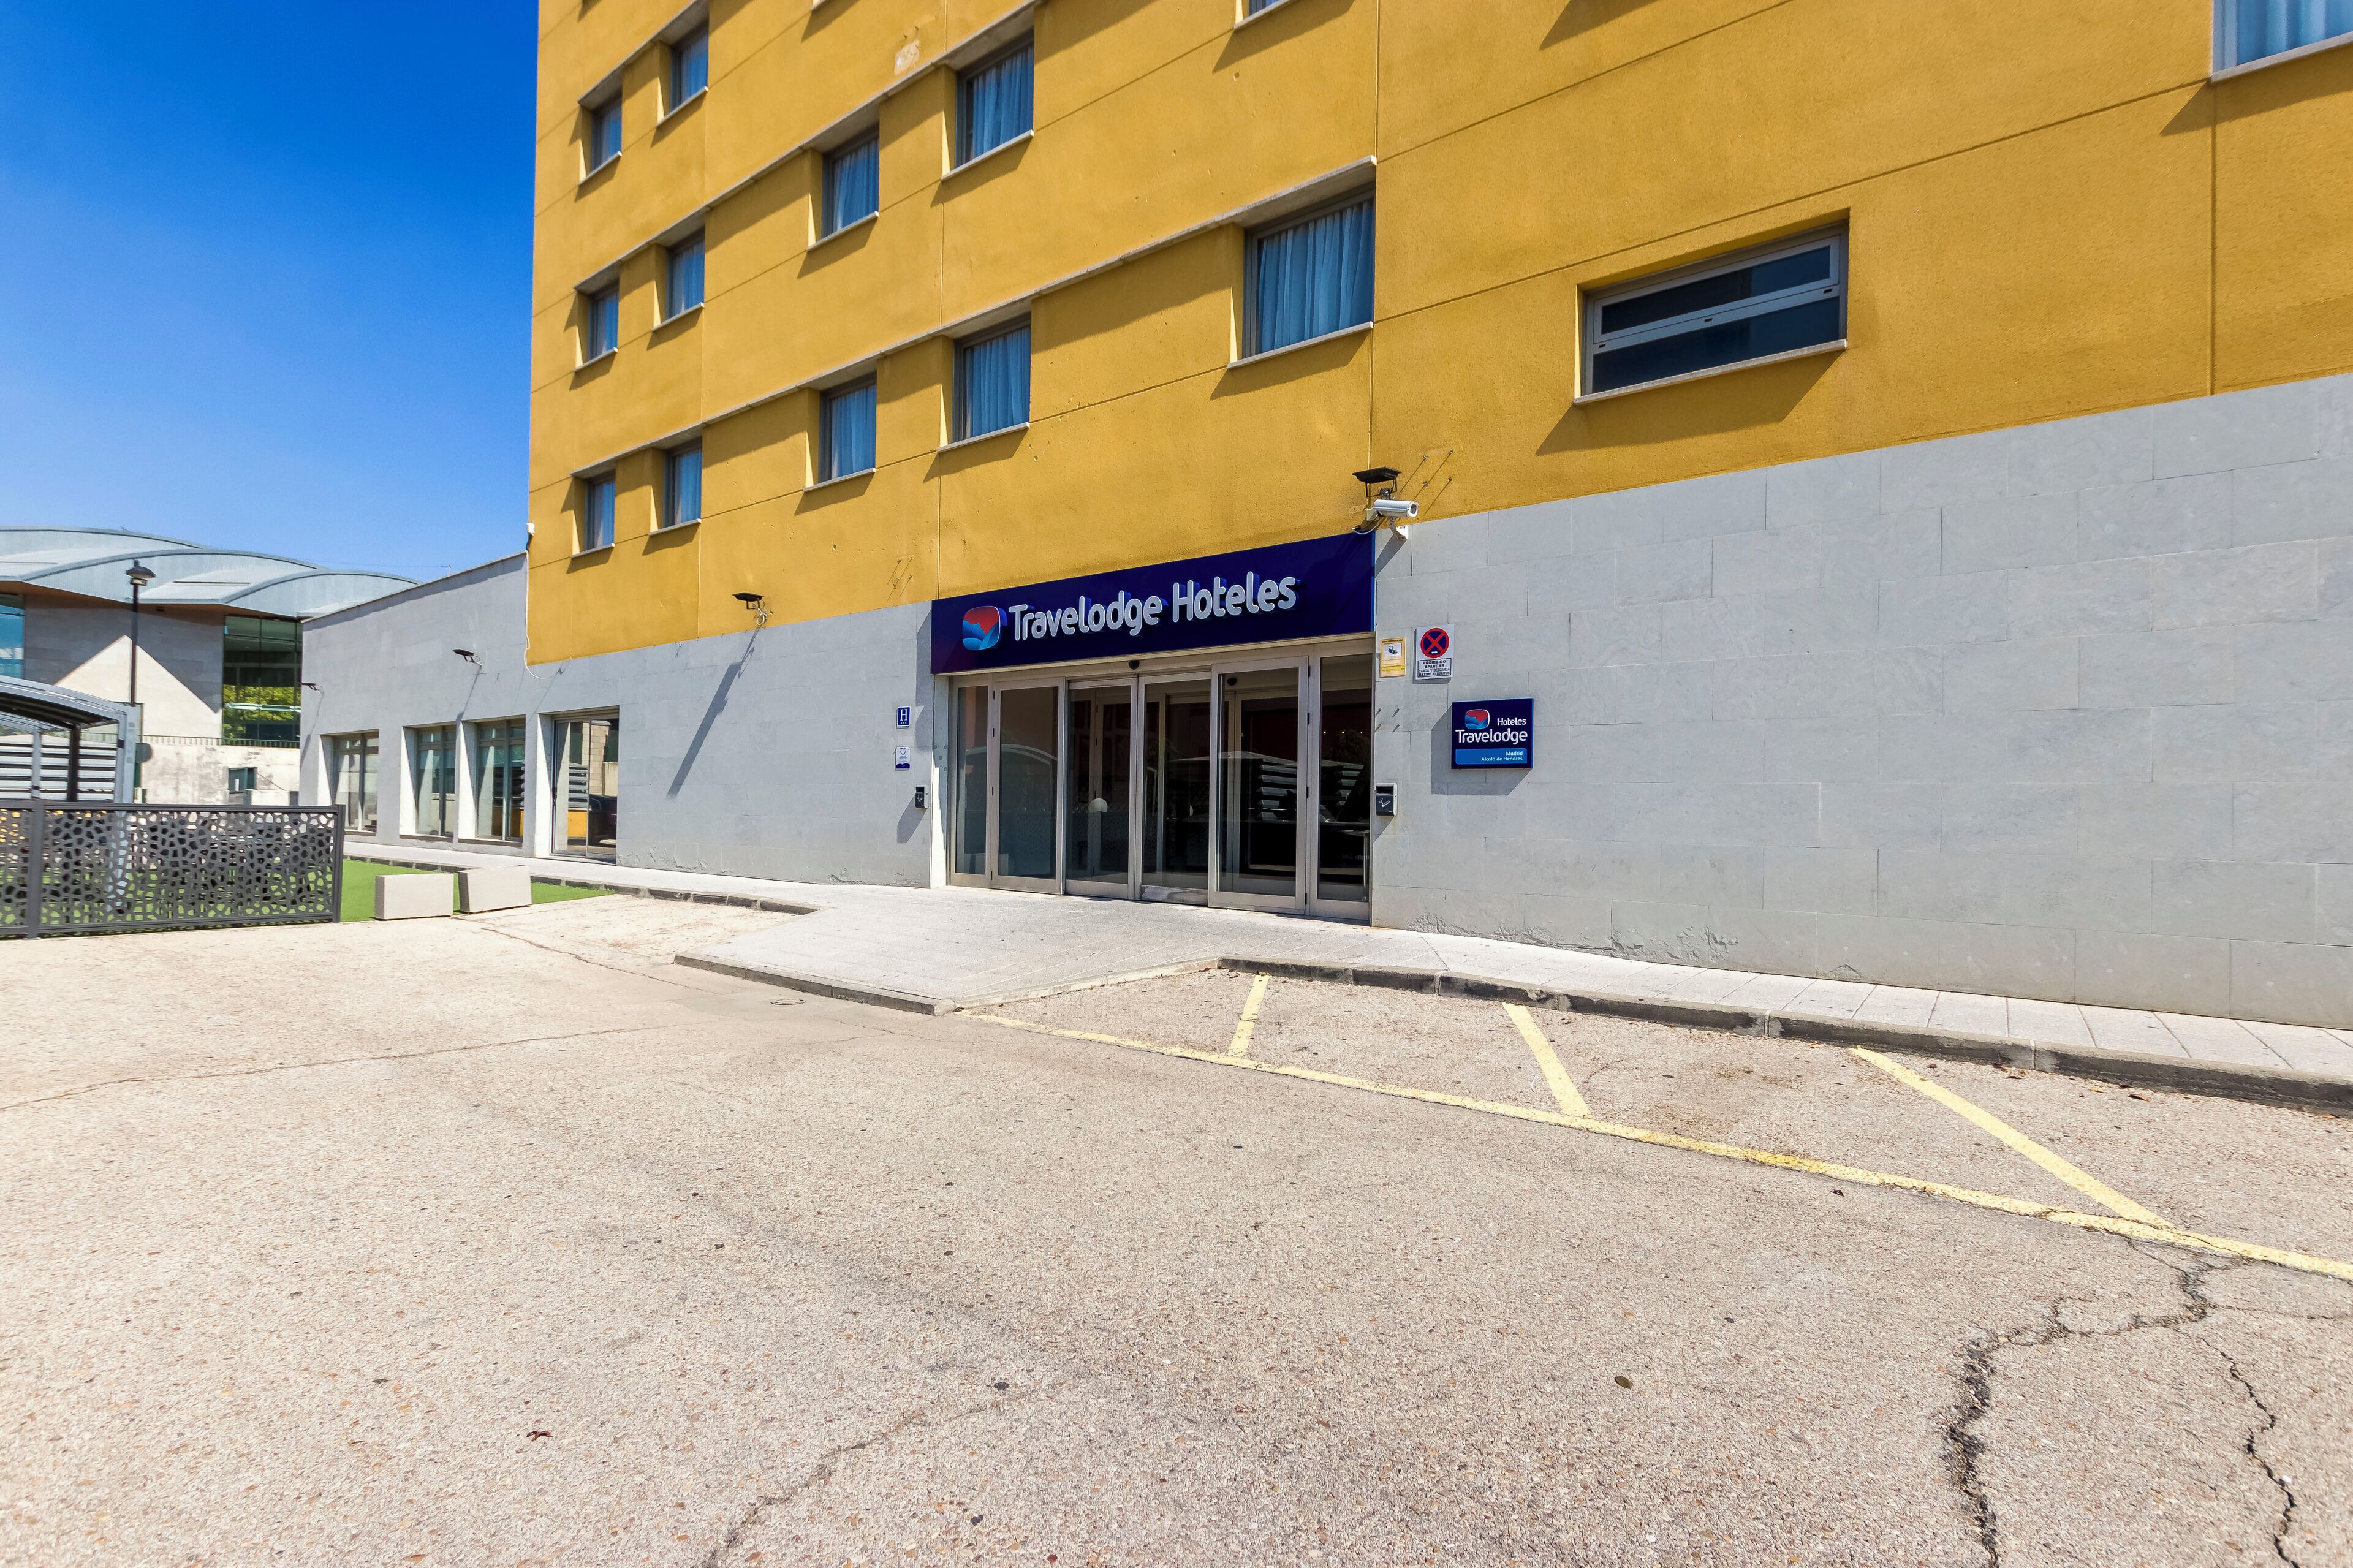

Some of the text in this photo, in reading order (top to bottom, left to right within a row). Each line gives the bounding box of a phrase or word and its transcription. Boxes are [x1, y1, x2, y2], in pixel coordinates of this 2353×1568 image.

[1009, 571, 1297, 641] Travelodge Hoteles
[900, 709, 907, 721] H
[1498, 717, 1526, 726] Hoteles
[1455, 727, 1528, 745] Travelodge
